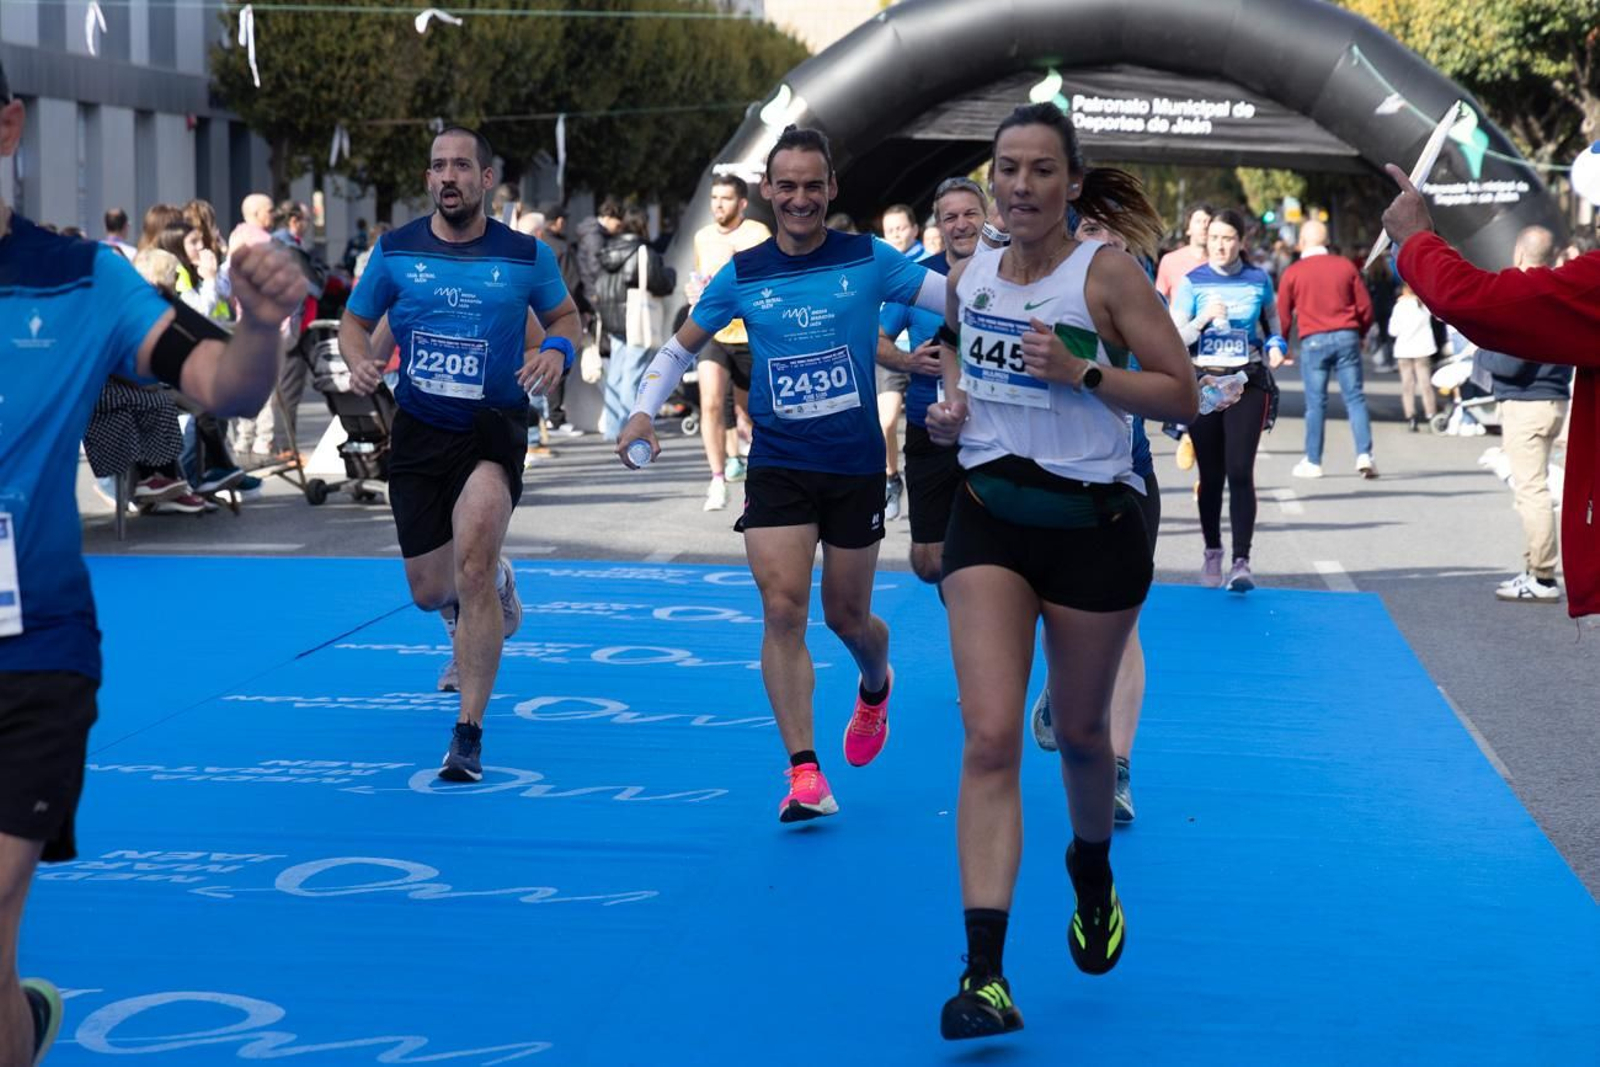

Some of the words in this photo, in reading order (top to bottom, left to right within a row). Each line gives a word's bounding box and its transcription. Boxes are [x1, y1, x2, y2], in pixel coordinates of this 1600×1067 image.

[1072, 94, 1150, 115] Patronato
[1151, 97, 1230, 119] Municipal
[1232, 101, 1256, 119] de
[1072, 112, 1145, 133] Deportes
[1147, 117, 1170, 133] de
[1171, 117, 1212, 134] Jaén
[969, 335, 1025, 372] 445
[1203, 338, 1244, 353] 2008
[416, 349, 479, 377] 2208
[777, 366, 847, 397] 2430
